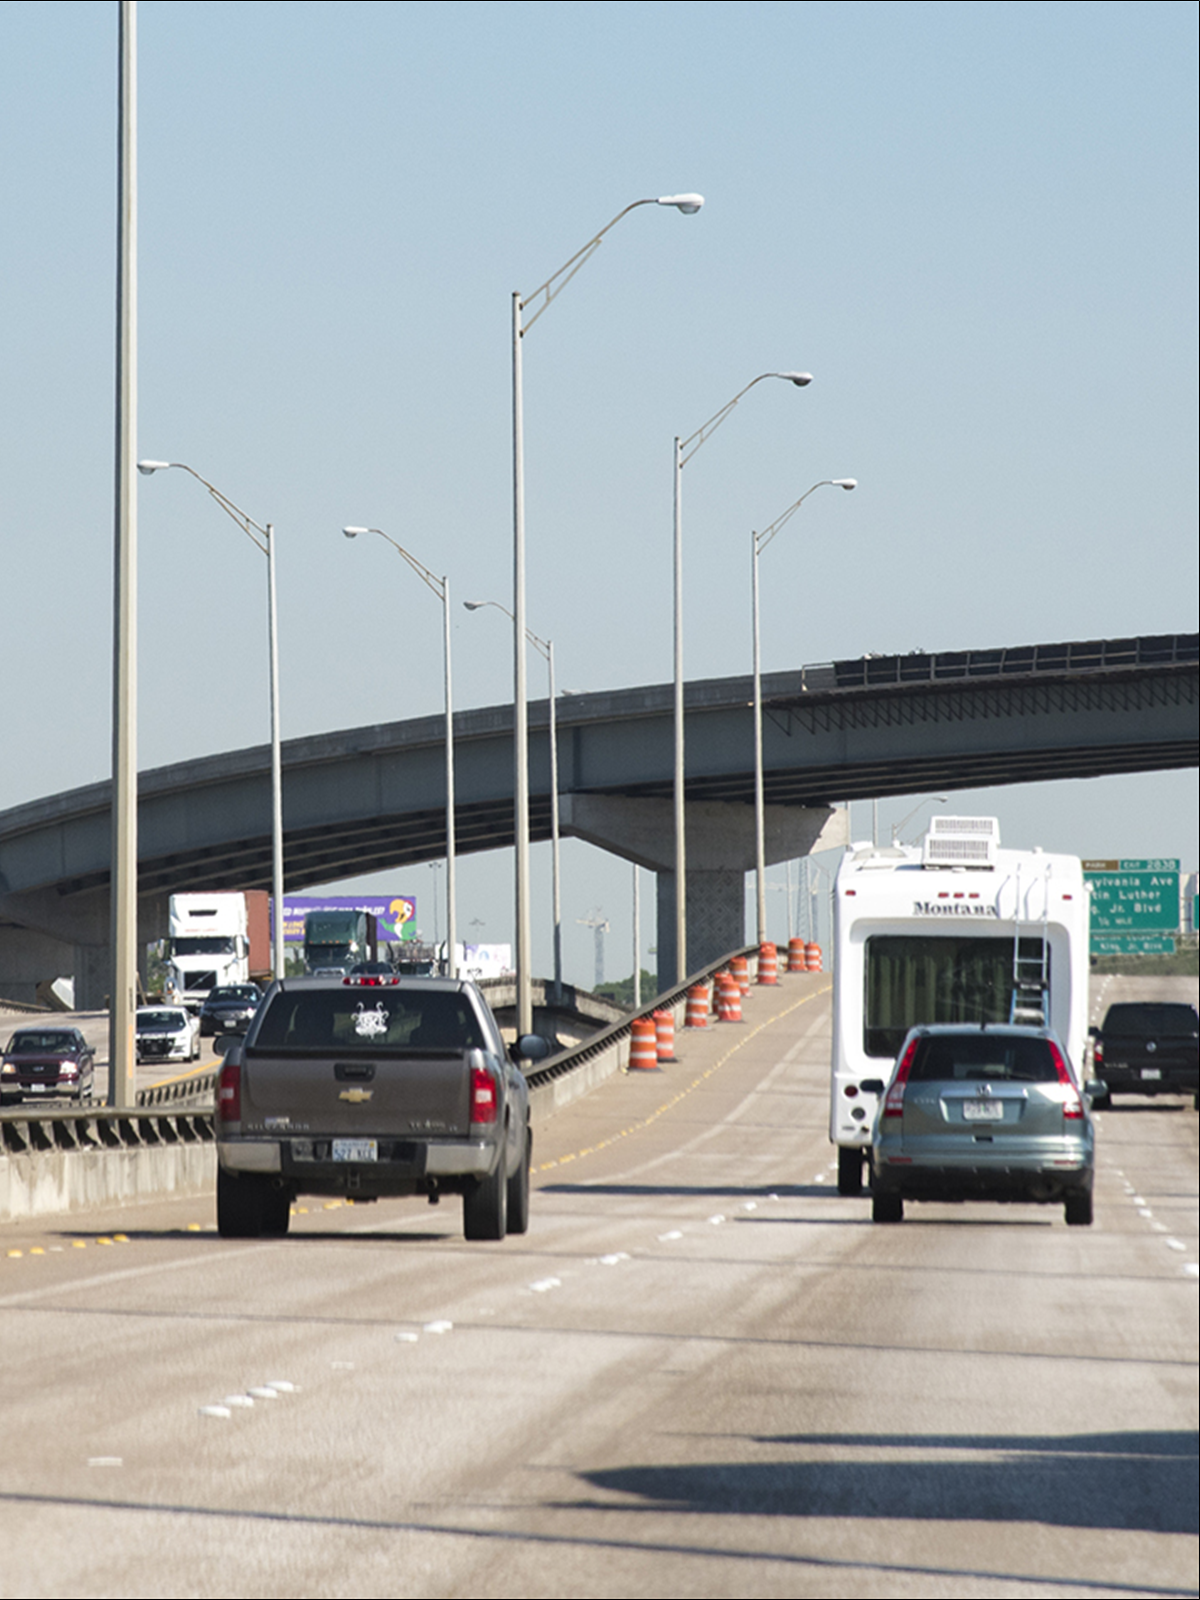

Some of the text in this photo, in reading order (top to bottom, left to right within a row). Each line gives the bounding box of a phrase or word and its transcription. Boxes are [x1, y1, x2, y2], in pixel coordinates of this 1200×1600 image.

[1091, 876, 1174, 888] ylvania Ave
[1118, 890, 1161, 900] Luther
[912, 901, 999, 916] Montana
[1133, 903, 1163, 914] Blvd
